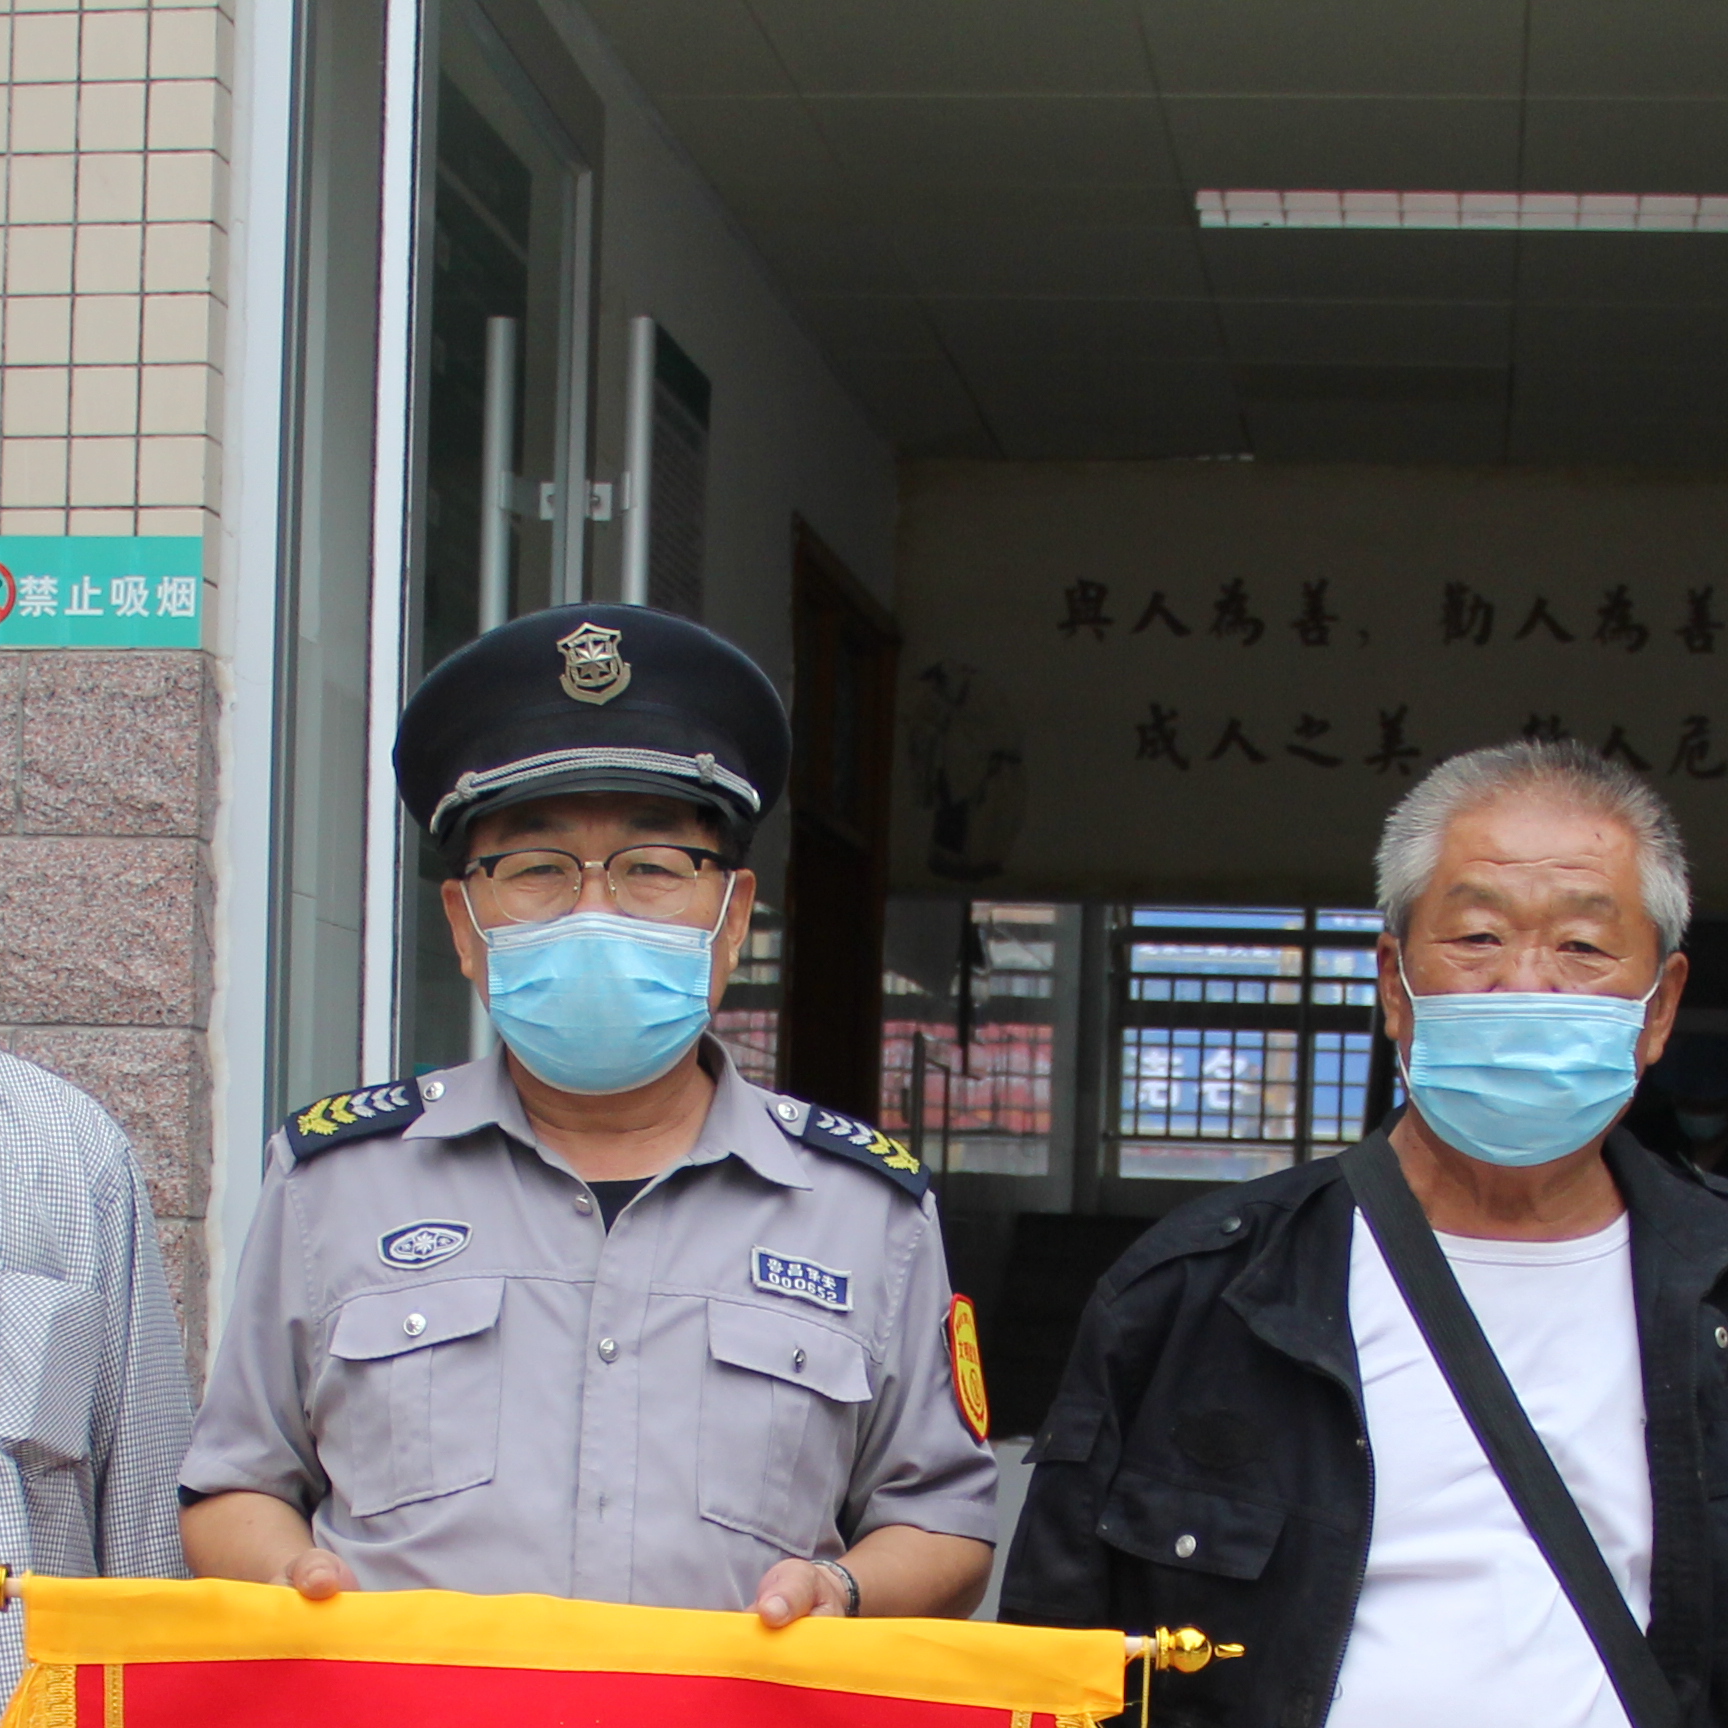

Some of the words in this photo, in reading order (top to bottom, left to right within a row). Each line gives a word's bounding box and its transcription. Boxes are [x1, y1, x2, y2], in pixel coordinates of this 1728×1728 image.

[18, 575, 197, 618] 禁止吸烟
[768, 1272, 838, 1304] 000652
